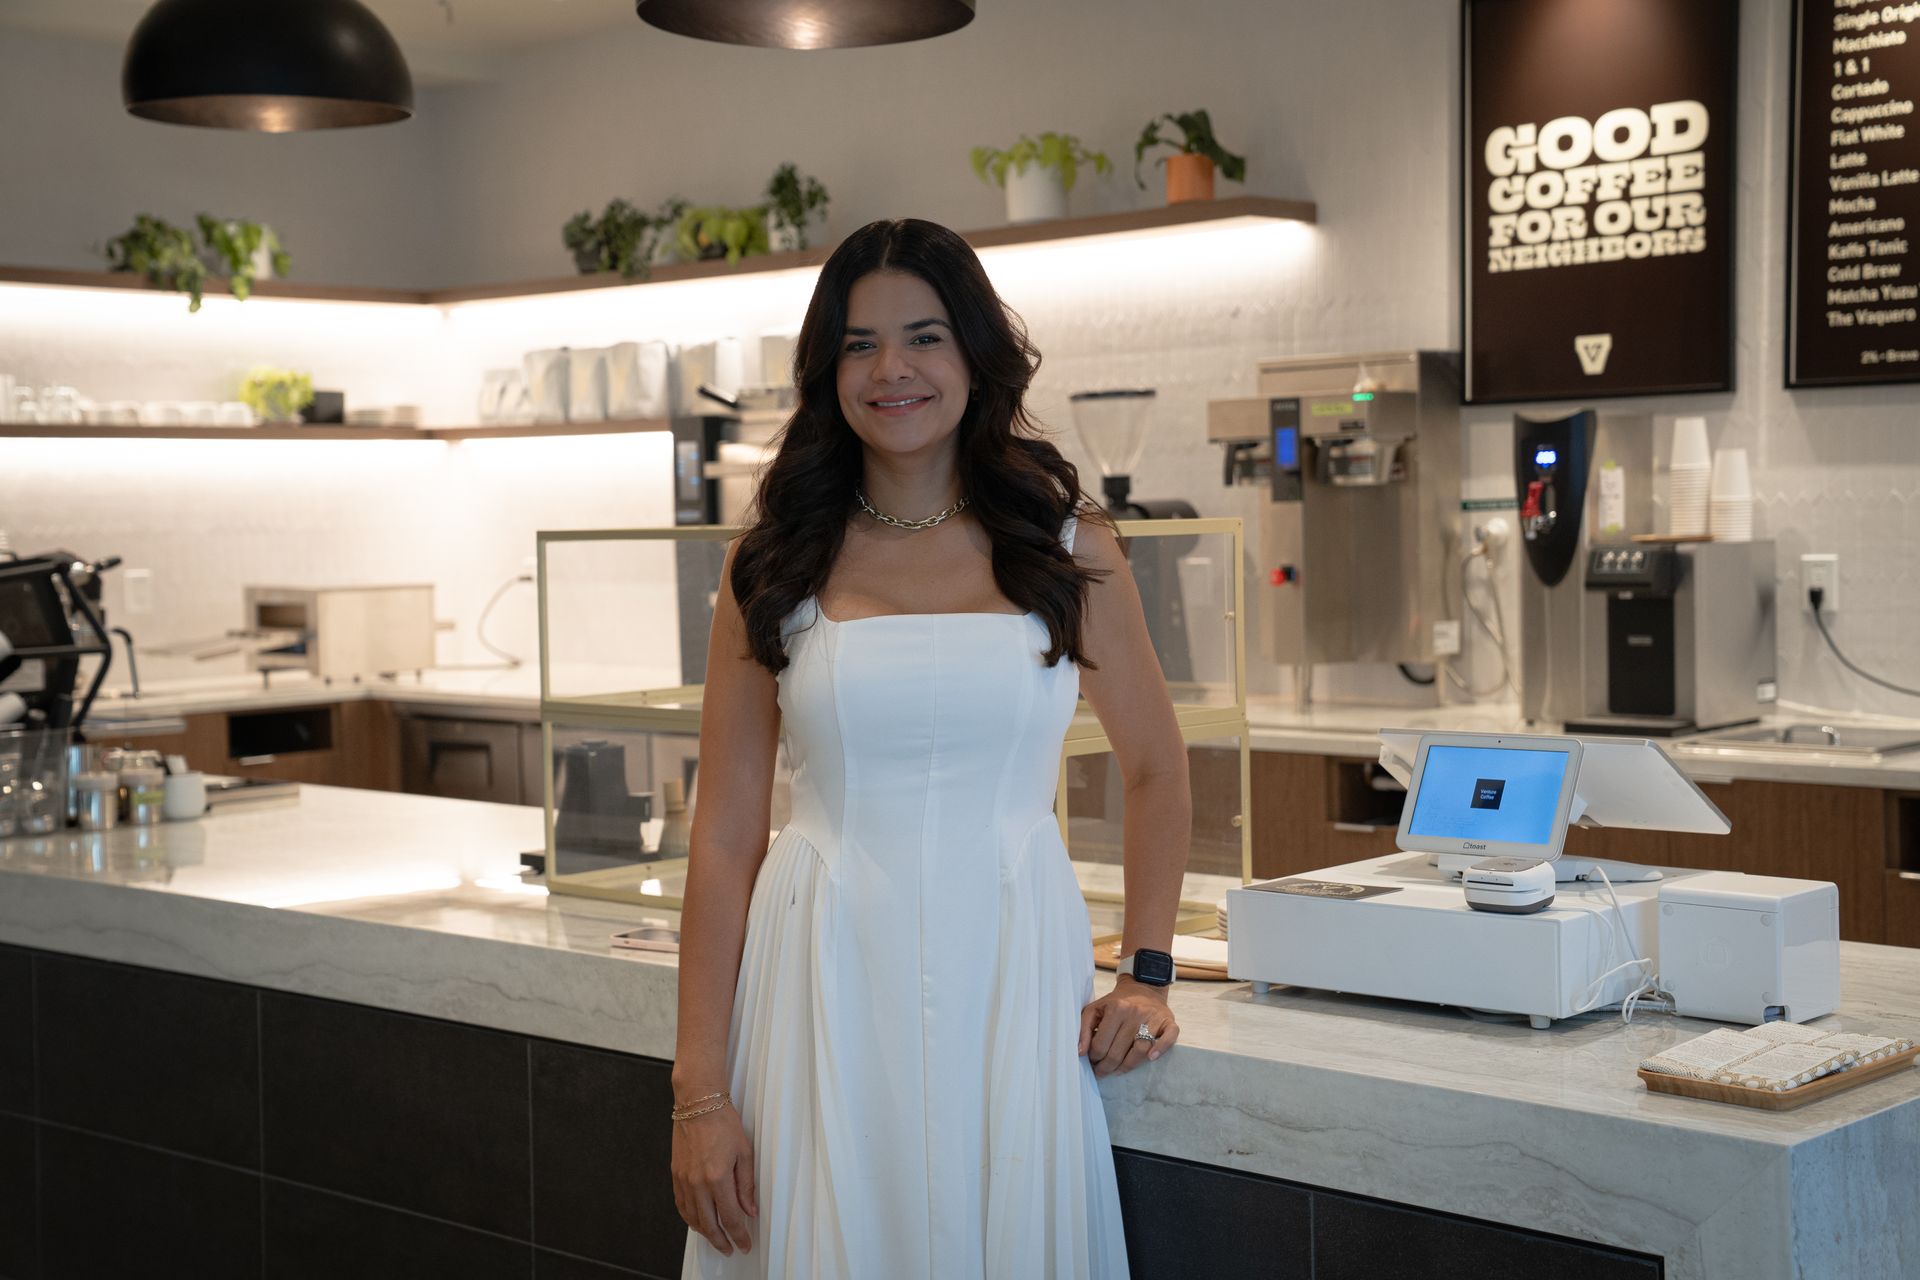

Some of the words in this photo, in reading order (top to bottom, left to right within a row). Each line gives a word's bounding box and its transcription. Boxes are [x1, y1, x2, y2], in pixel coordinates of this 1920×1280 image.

[1833, 10, 1880, 31] Single
[1881, 2, 1920, 23] Origi
[1833, 30, 1907, 54] Macchiato
[1833, 61, 1842, 77] 1
[1845, 58, 1858, 76] &
[1861, 56, 1871, 73] 1
[1831, 78, 1890, 100] Cortado
[1831, 100, 1914, 124] Cappuccino
[1485, 100, 1710, 176] GOOD
[1830, 128, 1860, 147] Flat
[1860, 123, 1905, 143] White
[1829, 152, 1867, 169] Latte
[1488, 151, 1705, 213] COFFEE
[1828, 172, 1880, 192] Vanilla
[1881, 168, 1920, 187] Latte
[1828, 196, 1876, 215] Mocha
[1488, 206, 1588, 247] FOR
[1593, 192, 1707, 236] OUR
[1828, 217, 1905, 237] Americano
[1488, 226, 1707, 273] NEIGHBORS
[1867, 237, 1909, 256] Tonic
[1827, 263, 1860, 283] Cold
[1862, 262, 1901, 280] Brew
[1827, 285, 1879, 305] Matcha
[1825, 310, 1855, 327] The
